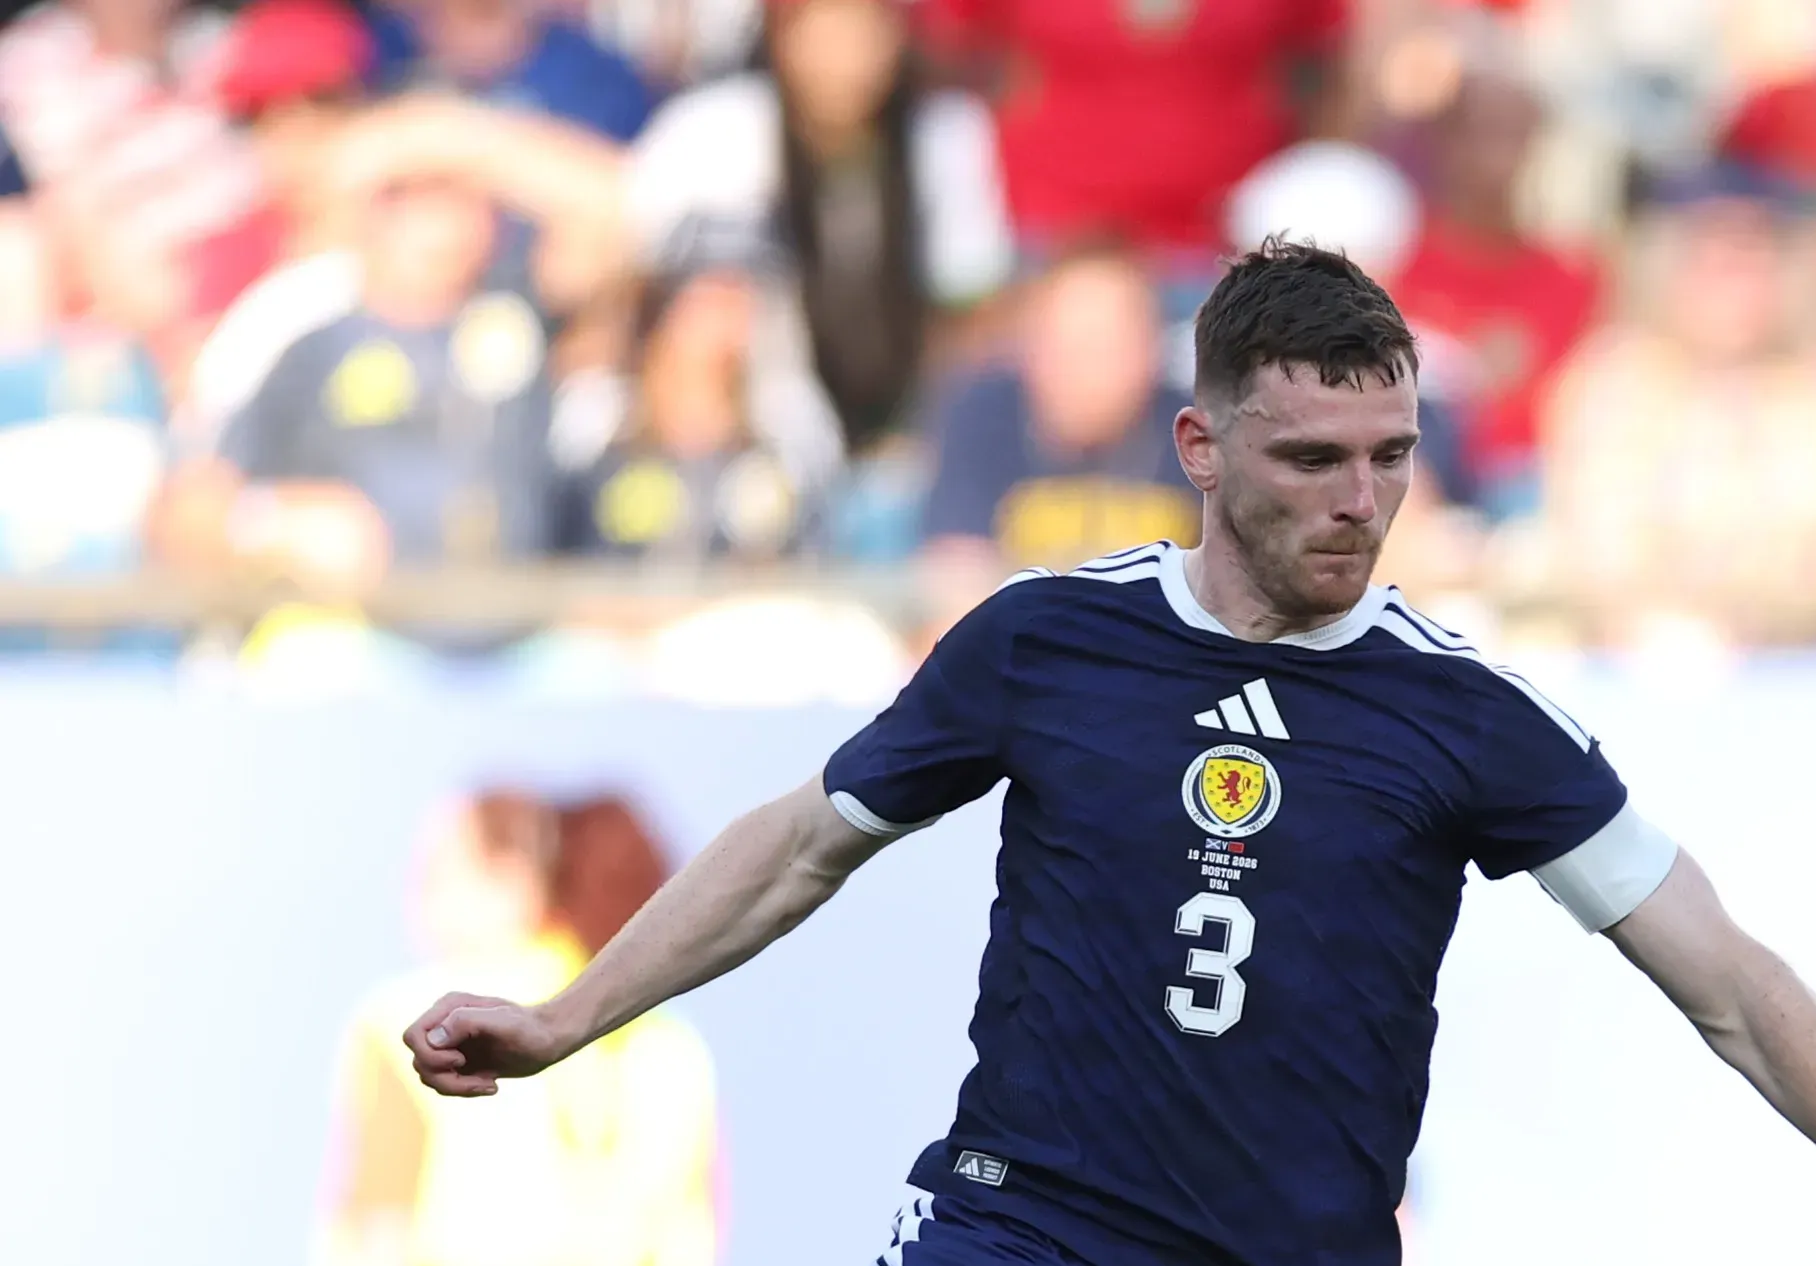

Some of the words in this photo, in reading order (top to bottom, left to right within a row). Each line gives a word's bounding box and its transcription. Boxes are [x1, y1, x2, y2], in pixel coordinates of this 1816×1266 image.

[1212, 746, 1261, 762] SCOTLAND
[1187, 848, 1200, 861] 19
[1201, 851, 1230, 865] JUNE
[1232, 855, 1258, 869] 2026
[1201, 864, 1241, 880] BOSTON
[1209, 878, 1229, 891] USA
[1164, 891, 1257, 1038] 3
